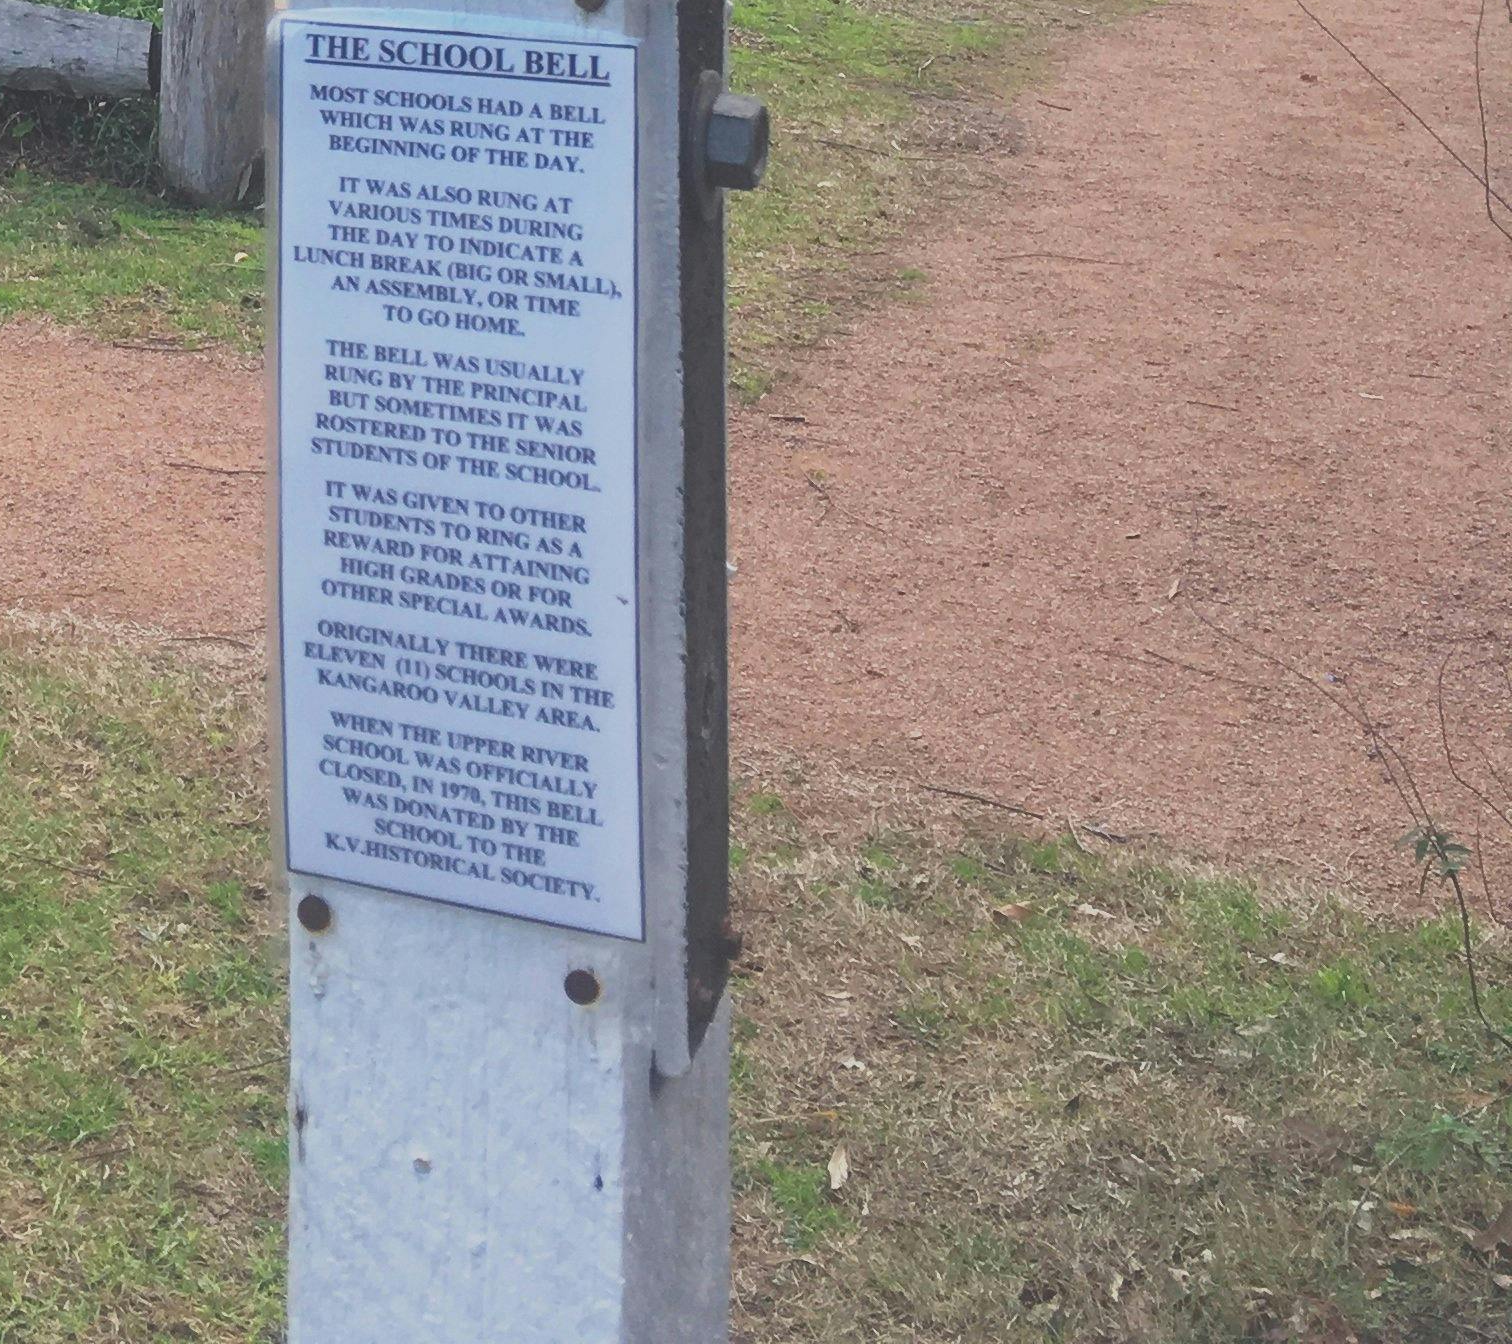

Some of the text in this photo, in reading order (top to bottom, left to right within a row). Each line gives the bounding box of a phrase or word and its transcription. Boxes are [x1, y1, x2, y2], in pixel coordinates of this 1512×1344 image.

[306, 33, 610, 80] THE SCHOOL BELL
[310, 84, 606, 124] MOST SCHOOLS HAD A BELL
[320, 109, 593, 149] WHICH WAS RUNG AT THE
[329, 134, 584, 173] BEGINNING OF THE DAY.
[330, 200, 582, 241] VARIOUS TIMES DURING
[340, 176, 572, 215] IT WAS ALSO RUNG AT
[294, 245, 364, 269] LUNCH
[371, 253, 441, 277] BREAK
[448, 261, 491, 285] (BIG
[497, 266, 528, 287] OR
[328, 224, 583, 267] THE DAY TO INDICATE A
[331, 274, 360, 293] AN
[487, 290, 518, 310] OR
[524, 294, 580, 317] TIME
[383, 303, 524, 337] TO GO HOME.
[326, 339, 584, 386] THE BELL WAS USUALLY
[325, 364, 586, 413] RUNG BY THE PRINCIPAL
[329, 389, 582, 438] BUT SOMETIMES IT WAS
[316, 412, 596, 465] ROSTERED TO THE SENIOR
[311, 436, 600, 492] STUDENTS OF THE SCHOOL.
[326, 479, 586, 534] IT WAS GIVEN TO OTHER
[329, 504, 582, 559] STUDENTS TO RING AS A
[324, 529, 589, 585] REWARD FOR ATTAINING
[341, 556, 571, 608] HIGH GRADES OR FOR
[321, 578, 592, 637] OTHER SPECIAL AWARDS.
[318, 618, 598, 681] ORIGINALLY THERE WERE
[304, 641, 614, 709] ELEVEN (11) SCHOOLS IN THE
[318, 667, 600, 733] KANGAROO VALLEY AREA.
[323, 733, 597, 800] SCHOOL WAS OFFICIALLY
[330, 710, 588, 773] WHEN THE UPPER RIVER
[319, 757, 406, 792] CLOSED,
[412, 775, 433, 795] IN
[490, 789, 541, 815] THIS
[547, 800, 602, 827] BELL
[342, 786, 579, 848] WAS DONATED BY THE
[375, 817, 545, 867] SCHOOL TO THE
[500, 866, 600, 902] SOCIETY.
